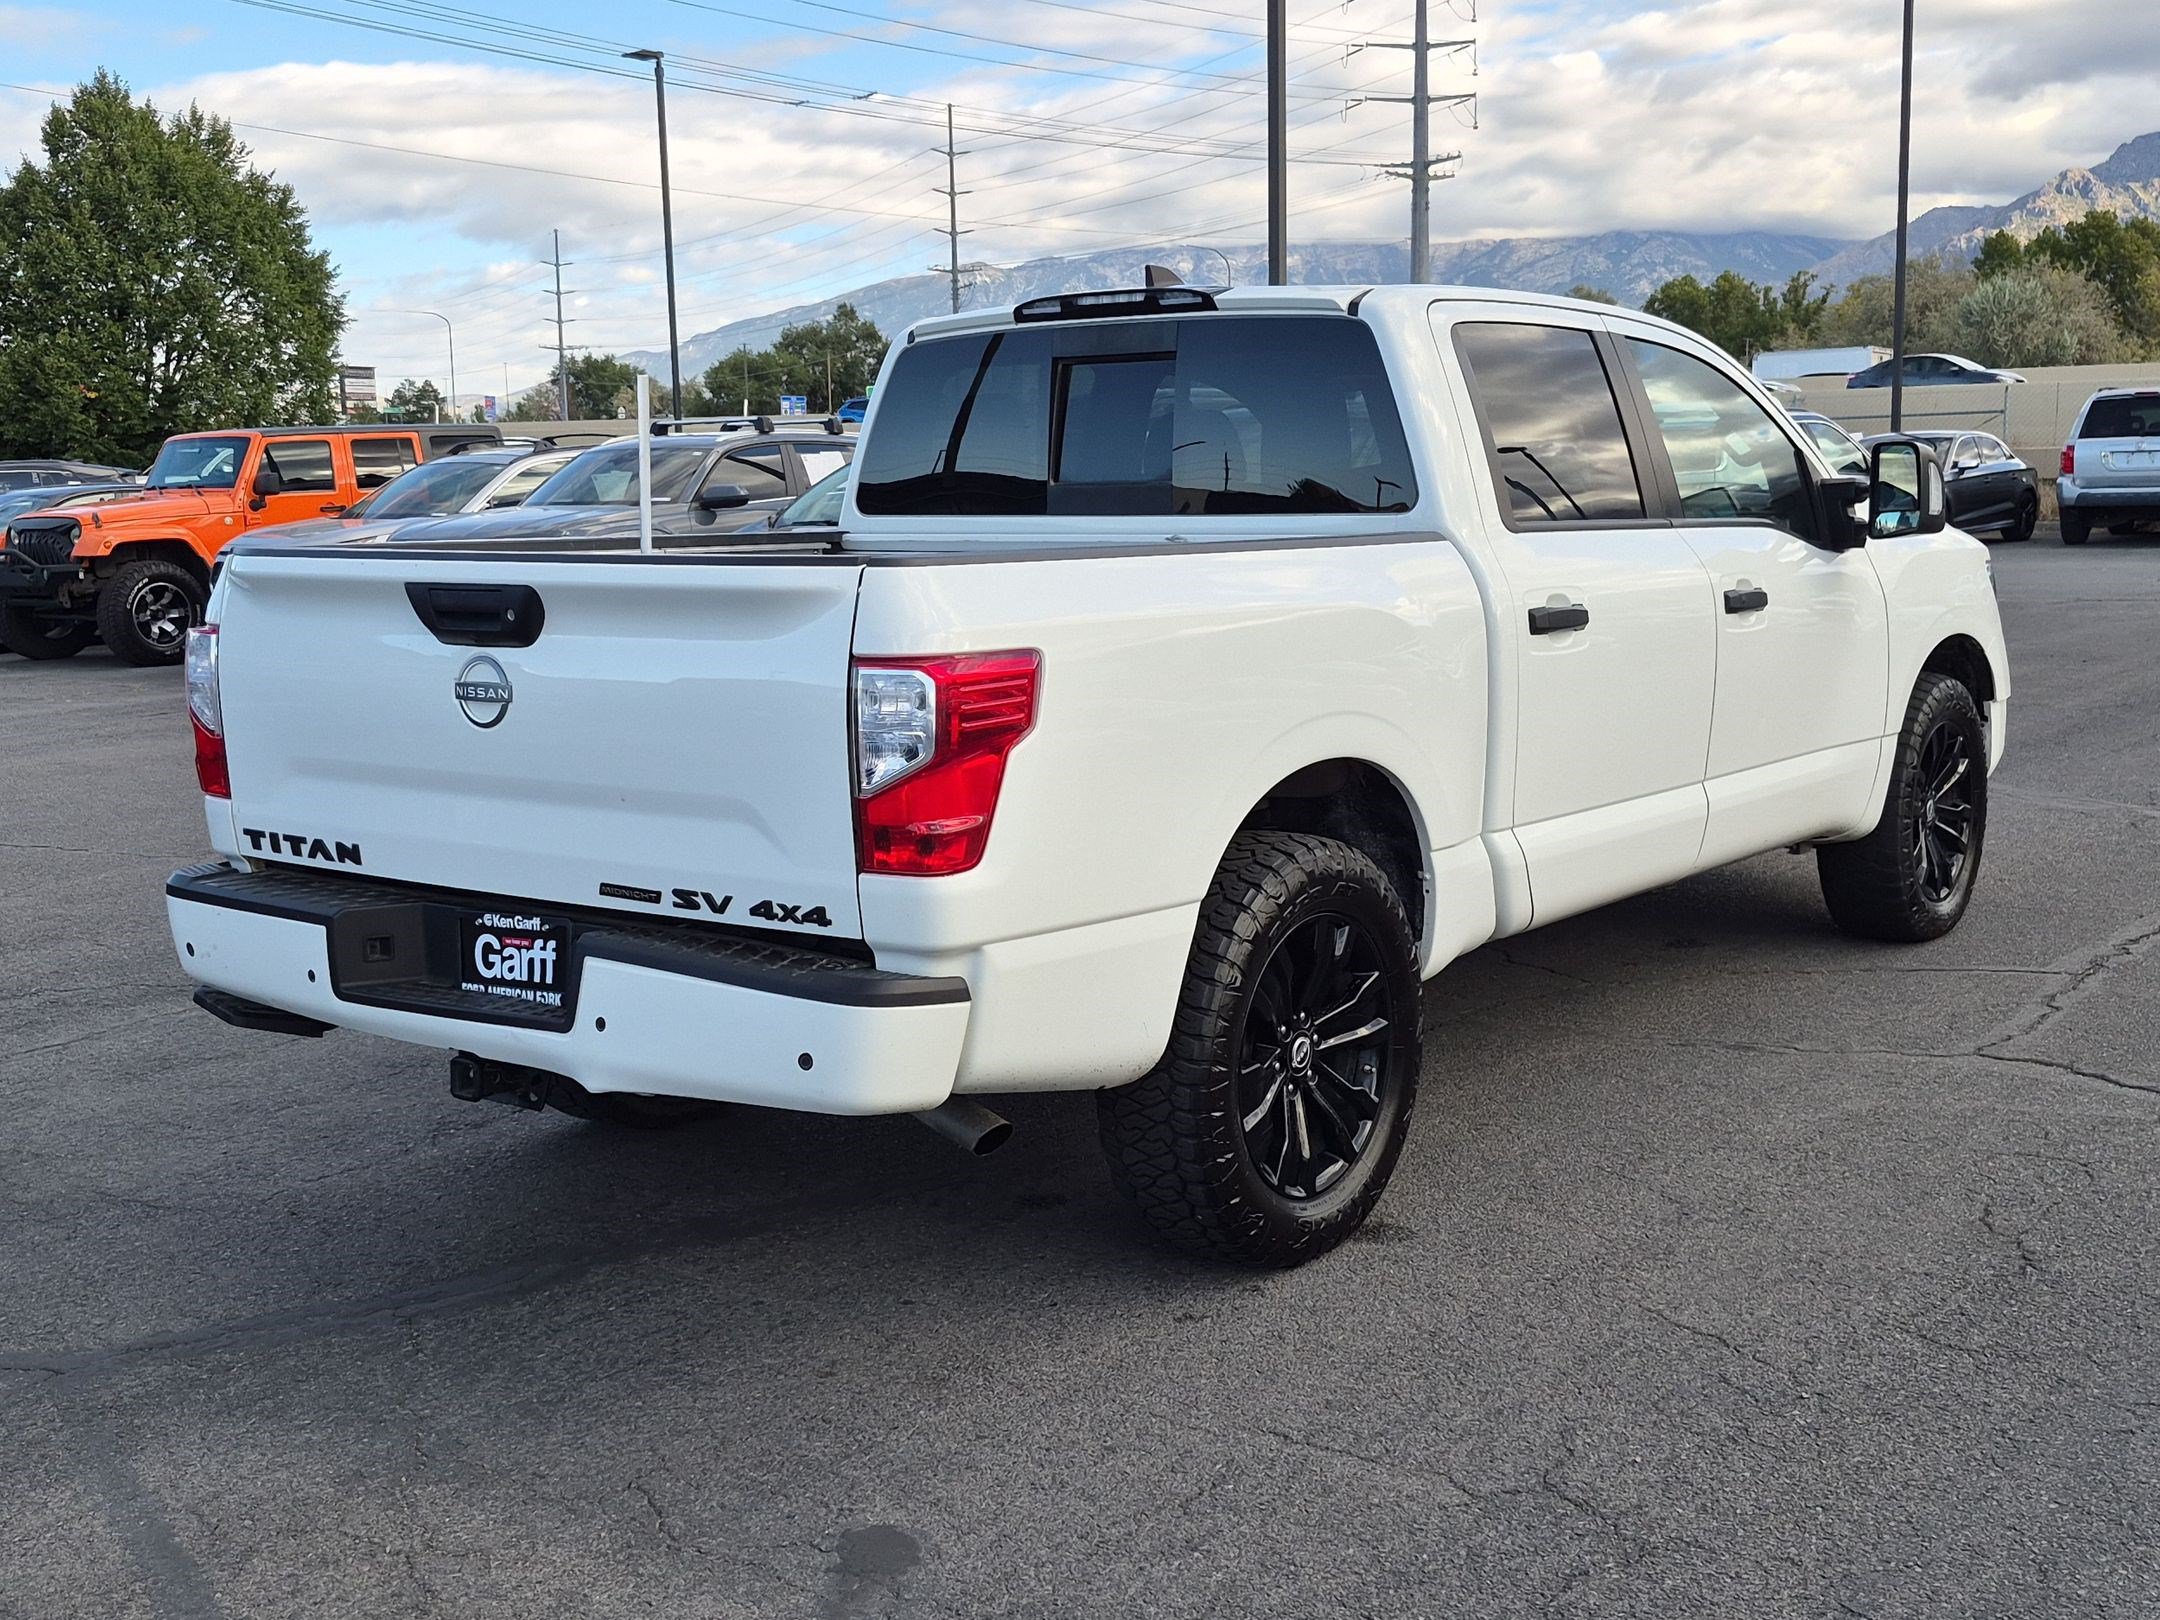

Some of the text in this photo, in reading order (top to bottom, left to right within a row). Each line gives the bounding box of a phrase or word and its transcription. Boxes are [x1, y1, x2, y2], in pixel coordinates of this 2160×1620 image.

[456, 686, 509, 699] NISSAN
[243, 827, 362, 866] TITAN
[601, 885, 658, 901] MIDNIGHT
[671, 888, 733, 914] SV
[492, 914, 541, 931] Ken Garff
[474, 933, 557, 984] Garff
[487, 985, 535, 1002] AMERICAN
[535, 991, 562, 1007] FORK
